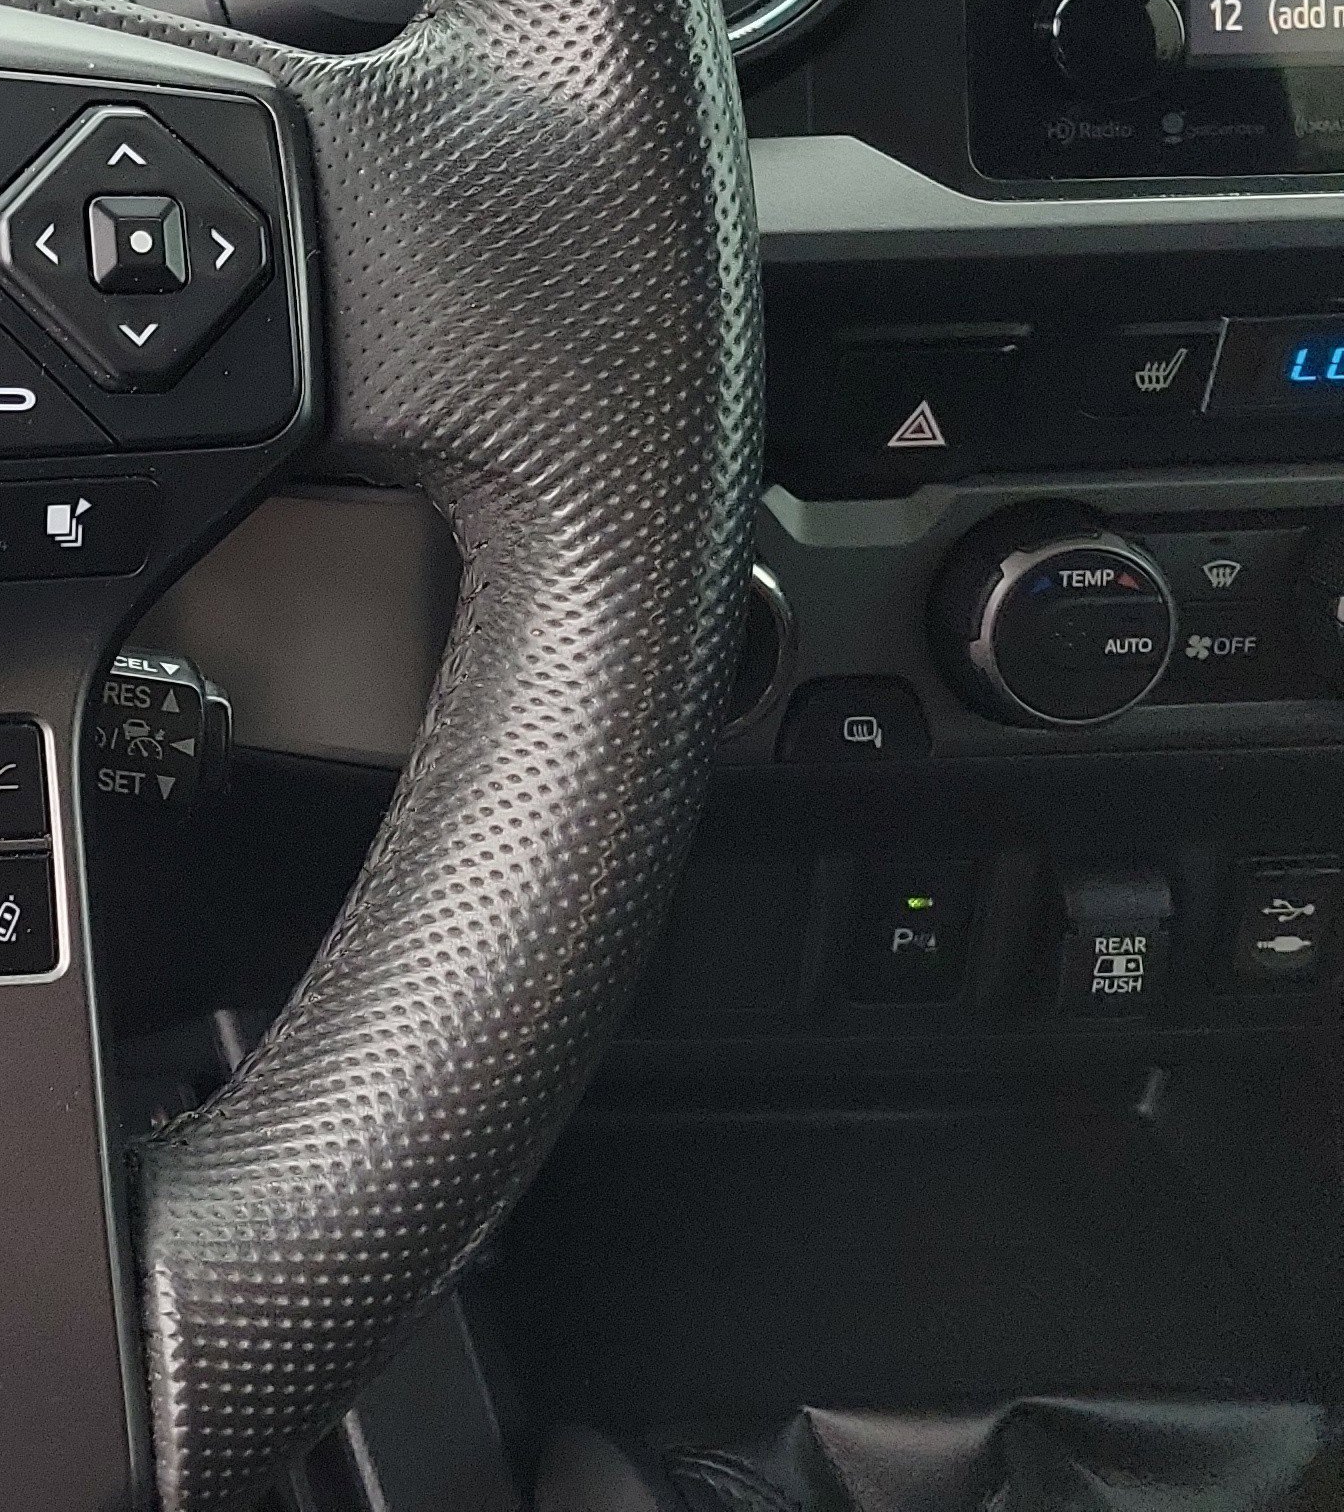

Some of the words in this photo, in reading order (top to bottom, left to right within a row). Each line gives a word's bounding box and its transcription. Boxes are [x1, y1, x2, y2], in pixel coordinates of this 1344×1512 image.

[1059, 569, 1115, 588] TEMP
[1104, 637, 1153, 654] AUTO
[1213, 637, 1257, 655] OFF
[102, 681, 152, 708] RES
[97, 767, 147, 796] SET
[1095, 936, 1147, 955] REAR
[1091, 977, 1142, 995] PUSH
